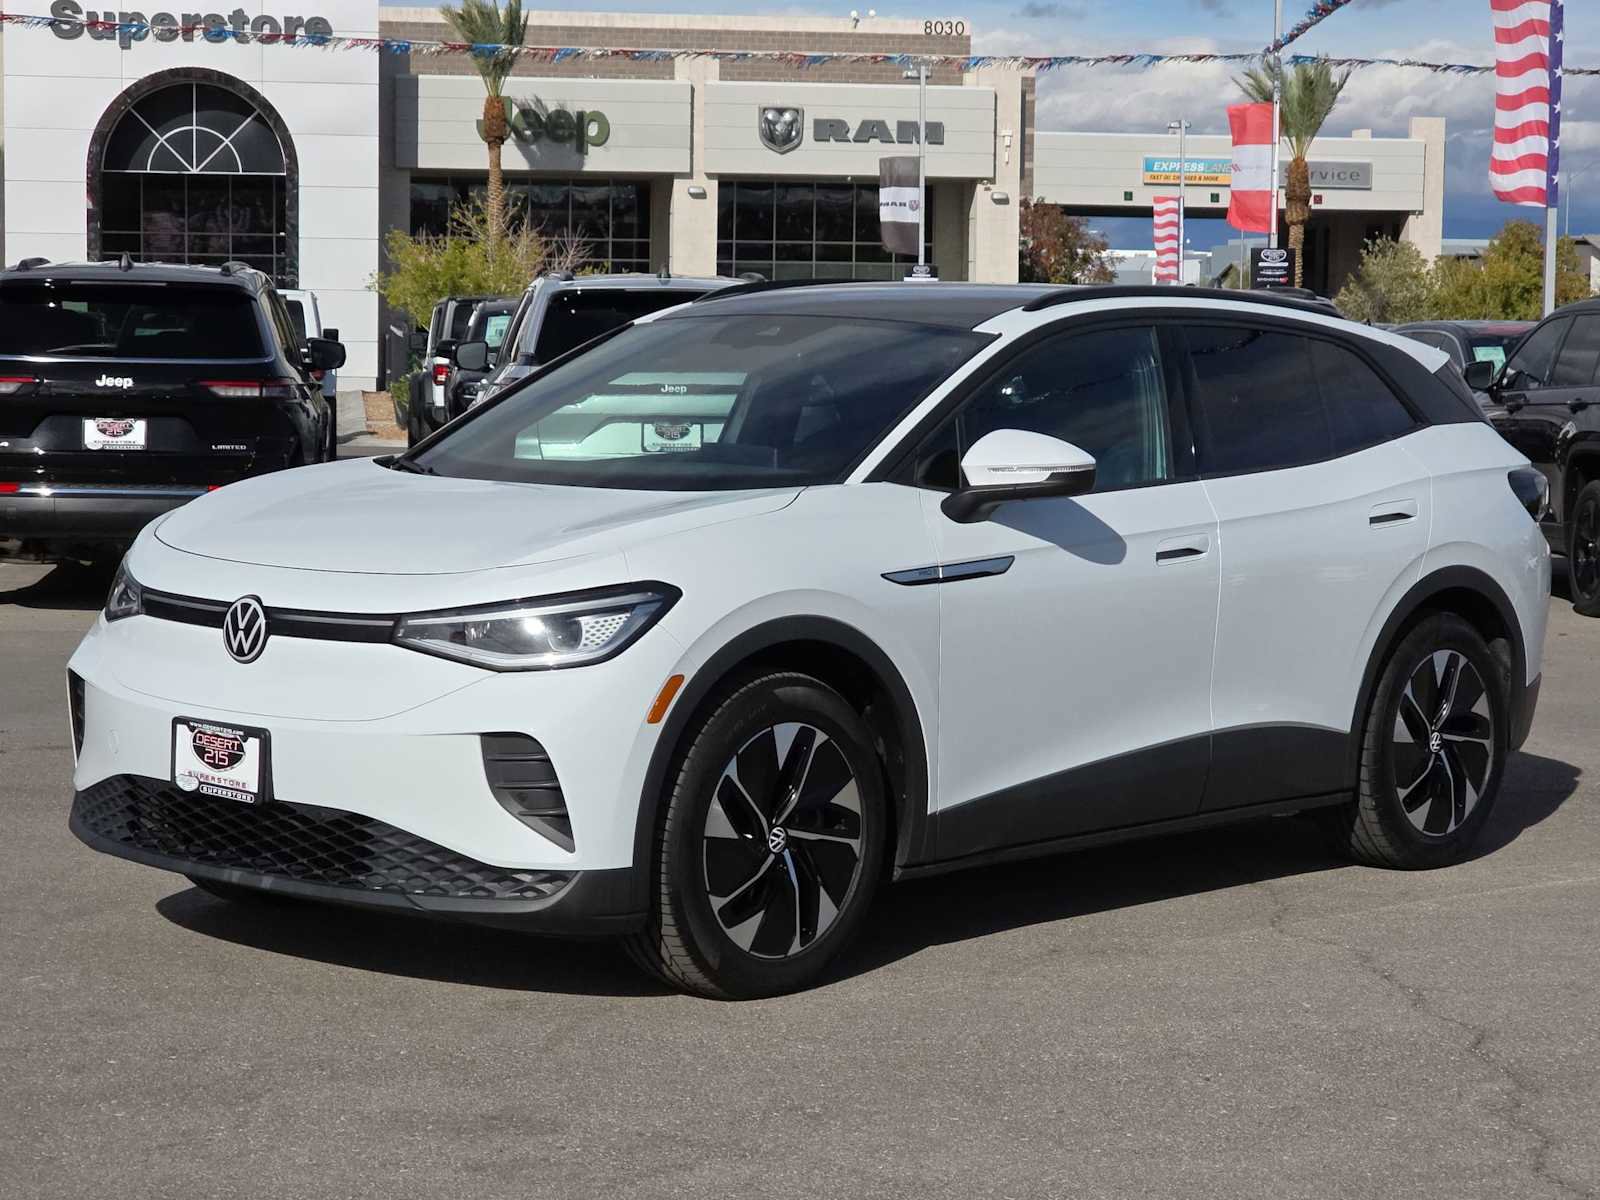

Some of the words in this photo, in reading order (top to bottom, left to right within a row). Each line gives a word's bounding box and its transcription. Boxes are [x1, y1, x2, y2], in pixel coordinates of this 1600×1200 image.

[51, 0, 333, 50] Superstore
[924, 20, 965, 36] 8030
[813, 118, 945, 145] RAM
[95, 374, 134, 390] Jeep
[660, 384, 688, 395] Jeep
[196, 733, 241, 751] DESERT
[204, 749, 229, 766] 215
[187, 770, 248, 789] SUPERSTORE
